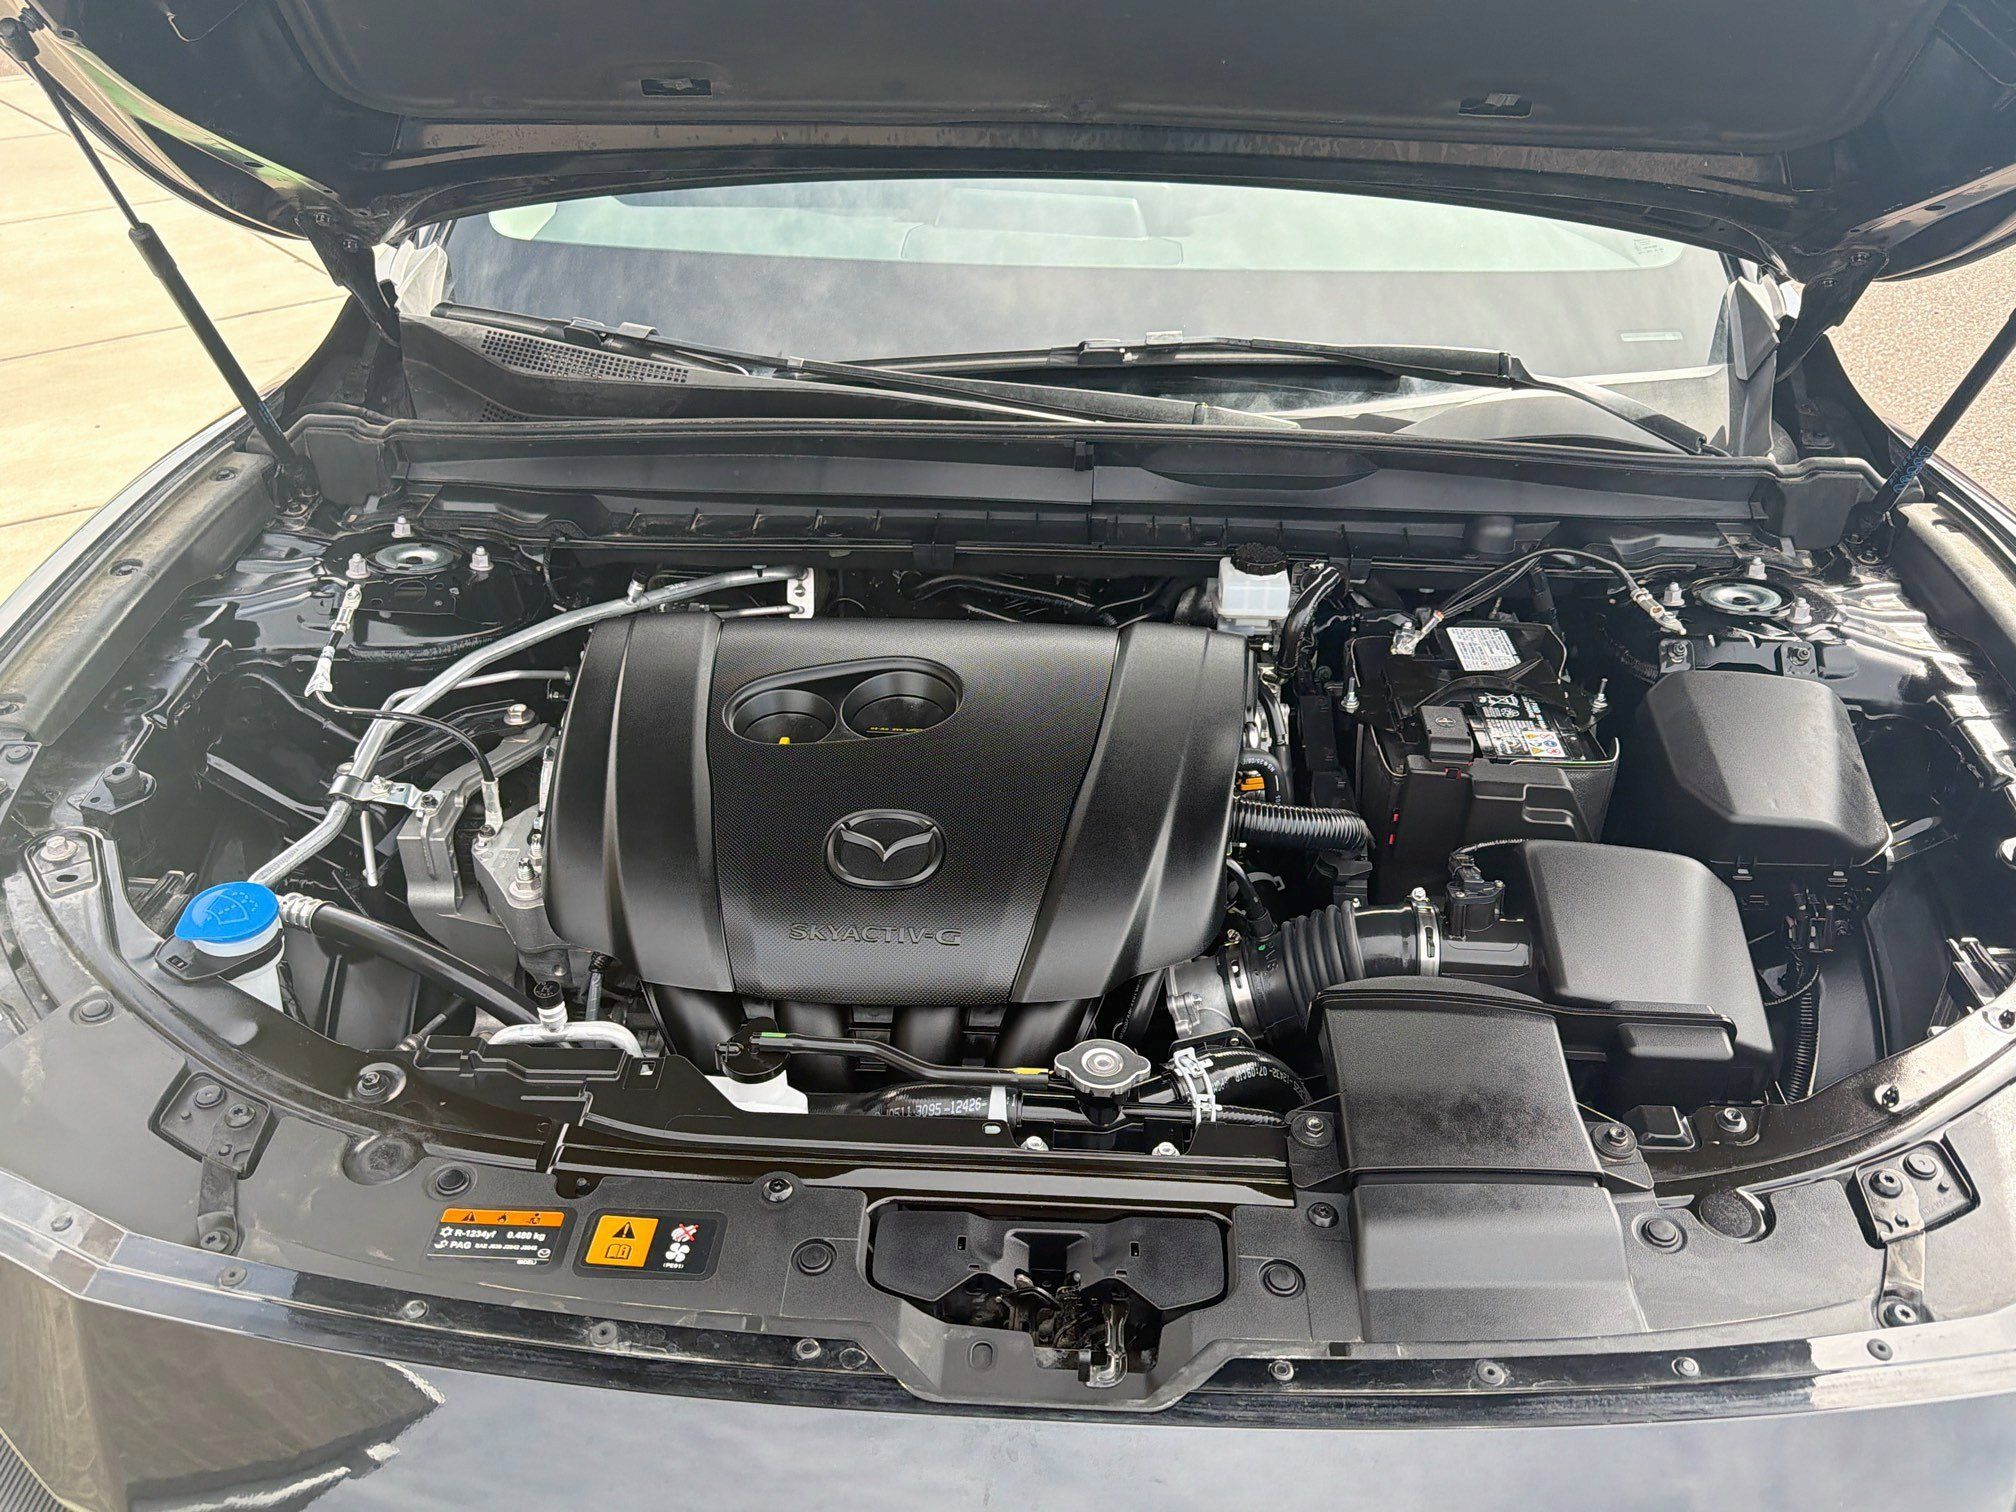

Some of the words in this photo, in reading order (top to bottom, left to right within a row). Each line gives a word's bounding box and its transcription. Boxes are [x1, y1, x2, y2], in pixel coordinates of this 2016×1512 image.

[789, 923, 962, 946] SKYACTIV-G
[454, 1229, 497, 1240] R-1234yf
[533, 1232, 546, 1242] kg
[449, 1241, 472, 1250] PAG
